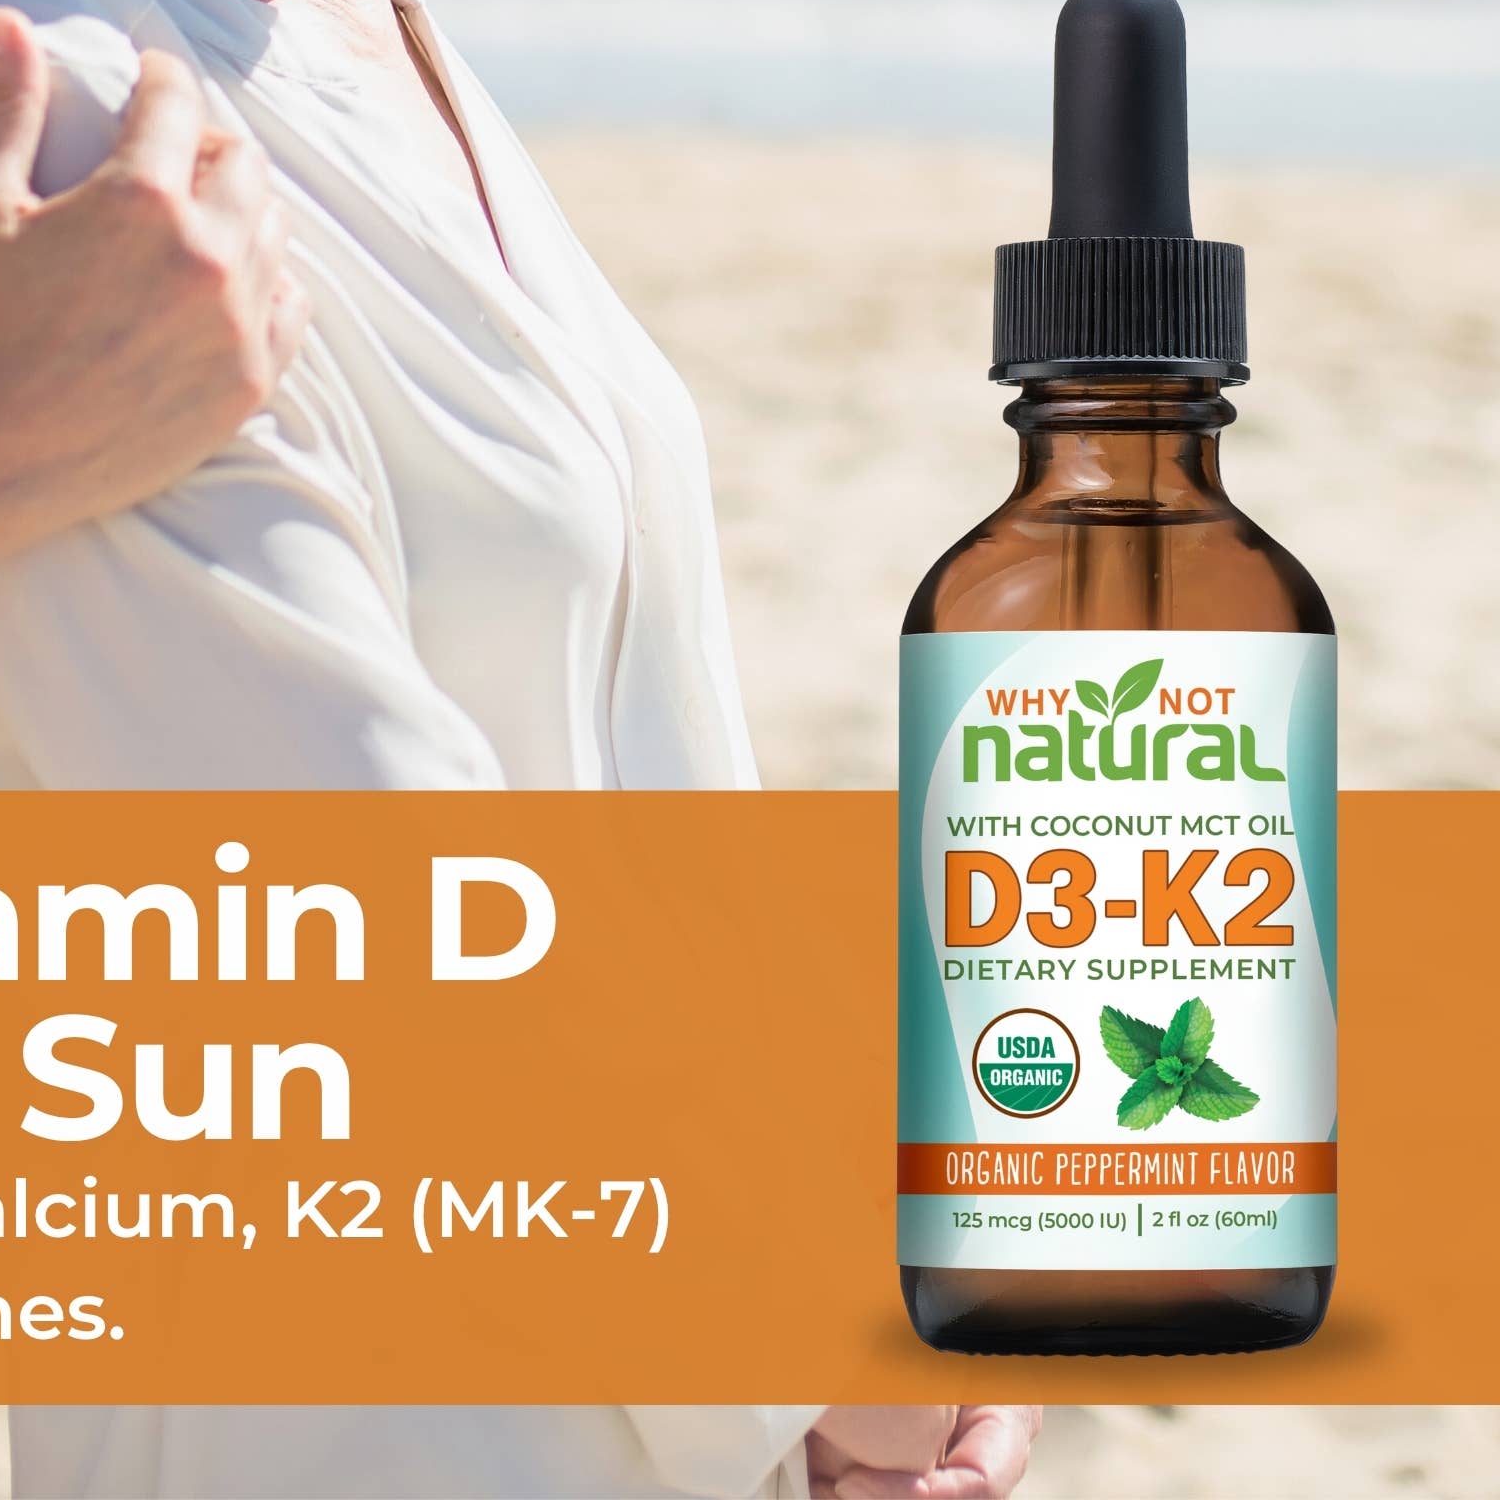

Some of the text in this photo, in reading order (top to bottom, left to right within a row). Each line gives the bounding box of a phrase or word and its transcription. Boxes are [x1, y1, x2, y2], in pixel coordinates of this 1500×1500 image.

[987, 688, 1235, 716] WHY NOT
[964, 710, 1284, 782] natural
[948, 815, 1294, 836] WITH COCONUT MCT OIL
[946, 848, 1294, 948] D3-K2
[945, 959, 1295, 980] DIETARY SUPPLEMENT
[998, 1037, 1055, 1058] USDA
[990, 1068, 1063, 1086] ORGANIC
[946, 1150, 1295, 1185] ORGANIC PEPPERMINT FLAVOR
[953, 1211, 1127, 1232] 125 mcg (5000 IU)
[1152, 1210, 1278, 1230] 2 fl oz (60ml)
